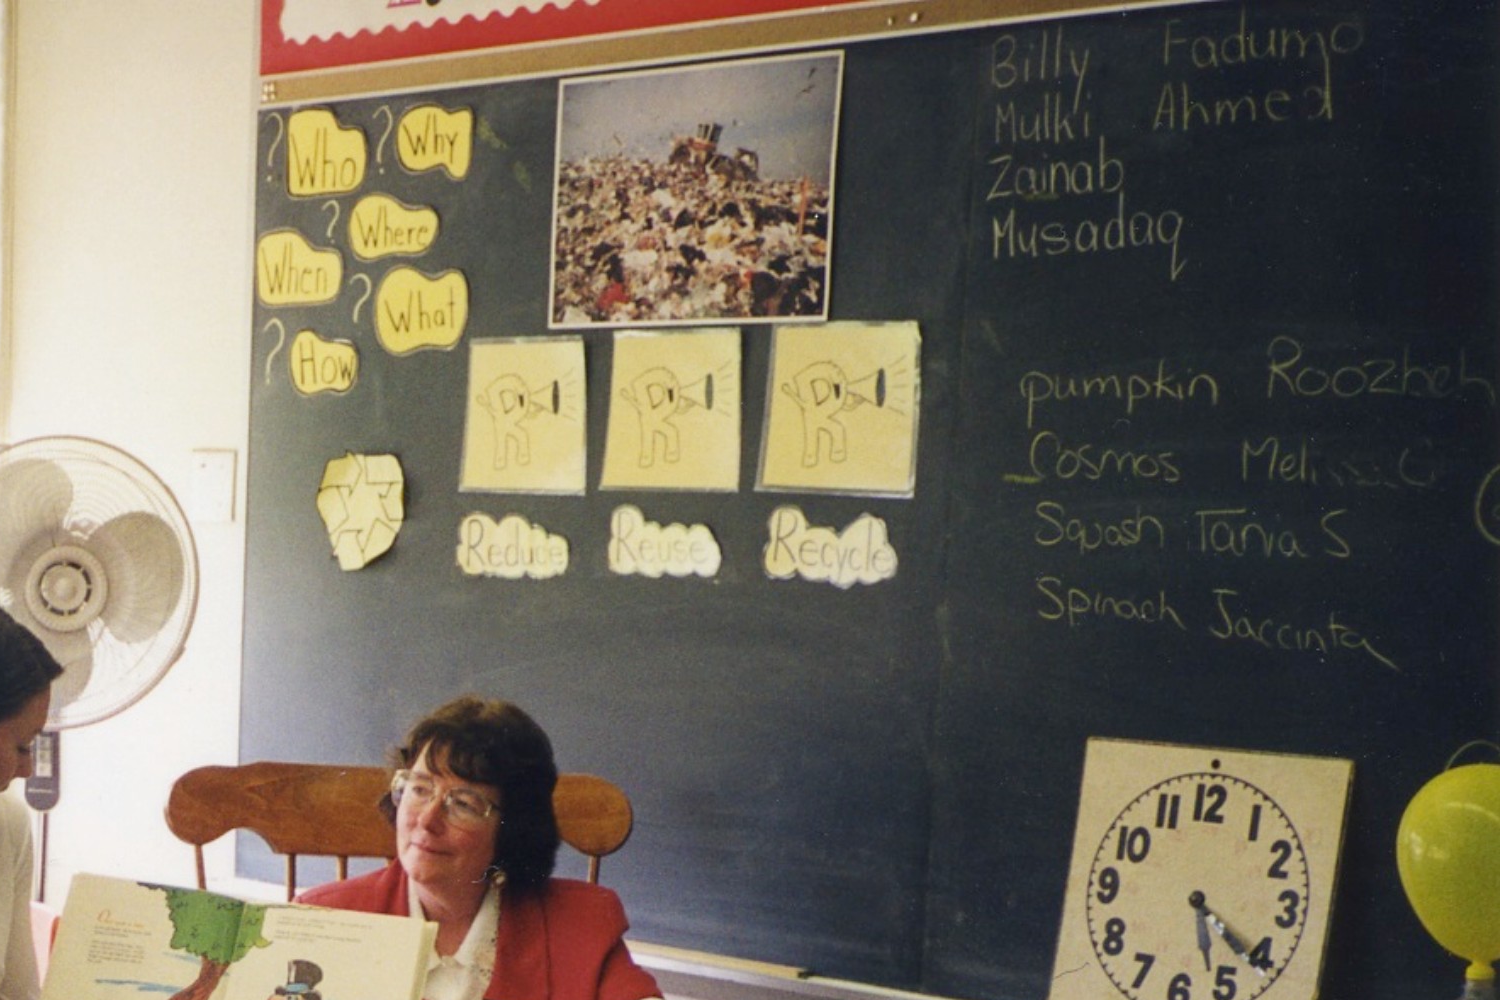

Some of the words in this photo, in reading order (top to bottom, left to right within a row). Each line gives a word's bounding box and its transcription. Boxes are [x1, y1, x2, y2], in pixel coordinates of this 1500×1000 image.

[990, 28, 1089, 113] Billy
[1163, 10, 1364, 69] Fadumo
[994, 90, 1091, 145] Mulki
[1153, 62, 1334, 132] Ahmed
[290, 126, 357, 189] Who
[403, 113, 459, 164] Why
[986, 134, 1125, 201] Zainab
[355, 205, 430, 249] Where
[992, 191, 1187, 281] Musadaq
[261, 241, 329, 296] When
[384, 287, 457, 334] What
[299, 339, 355, 387] How
[1019, 359, 1220, 428] pumpkin
[1029, 430, 1181, 482] Cosmos
[467, 517, 563, 569] Reduce
[615, 508, 708, 566] Reuse
[773, 508, 894, 577] Recycle
[1035, 500, 1165, 556] Squash
[1320, 508, 1352, 559] S
[1036, 576, 1187, 631] Spinach
[1155, 793, 1181, 829] 11
[1193, 783, 1228, 824] 12
[1248, 804, 1262, 841] 1
[1116, 826, 1151, 863] 10
[1267, 840, 1293, 879] 2
[1096, 867, 1120, 904] 9
[1274, 890, 1300, 929] 3
[1102, 918, 1126, 956] 8
[1248, 937, 1274, 974] 4
[1131, 953, 1156, 989] 7
